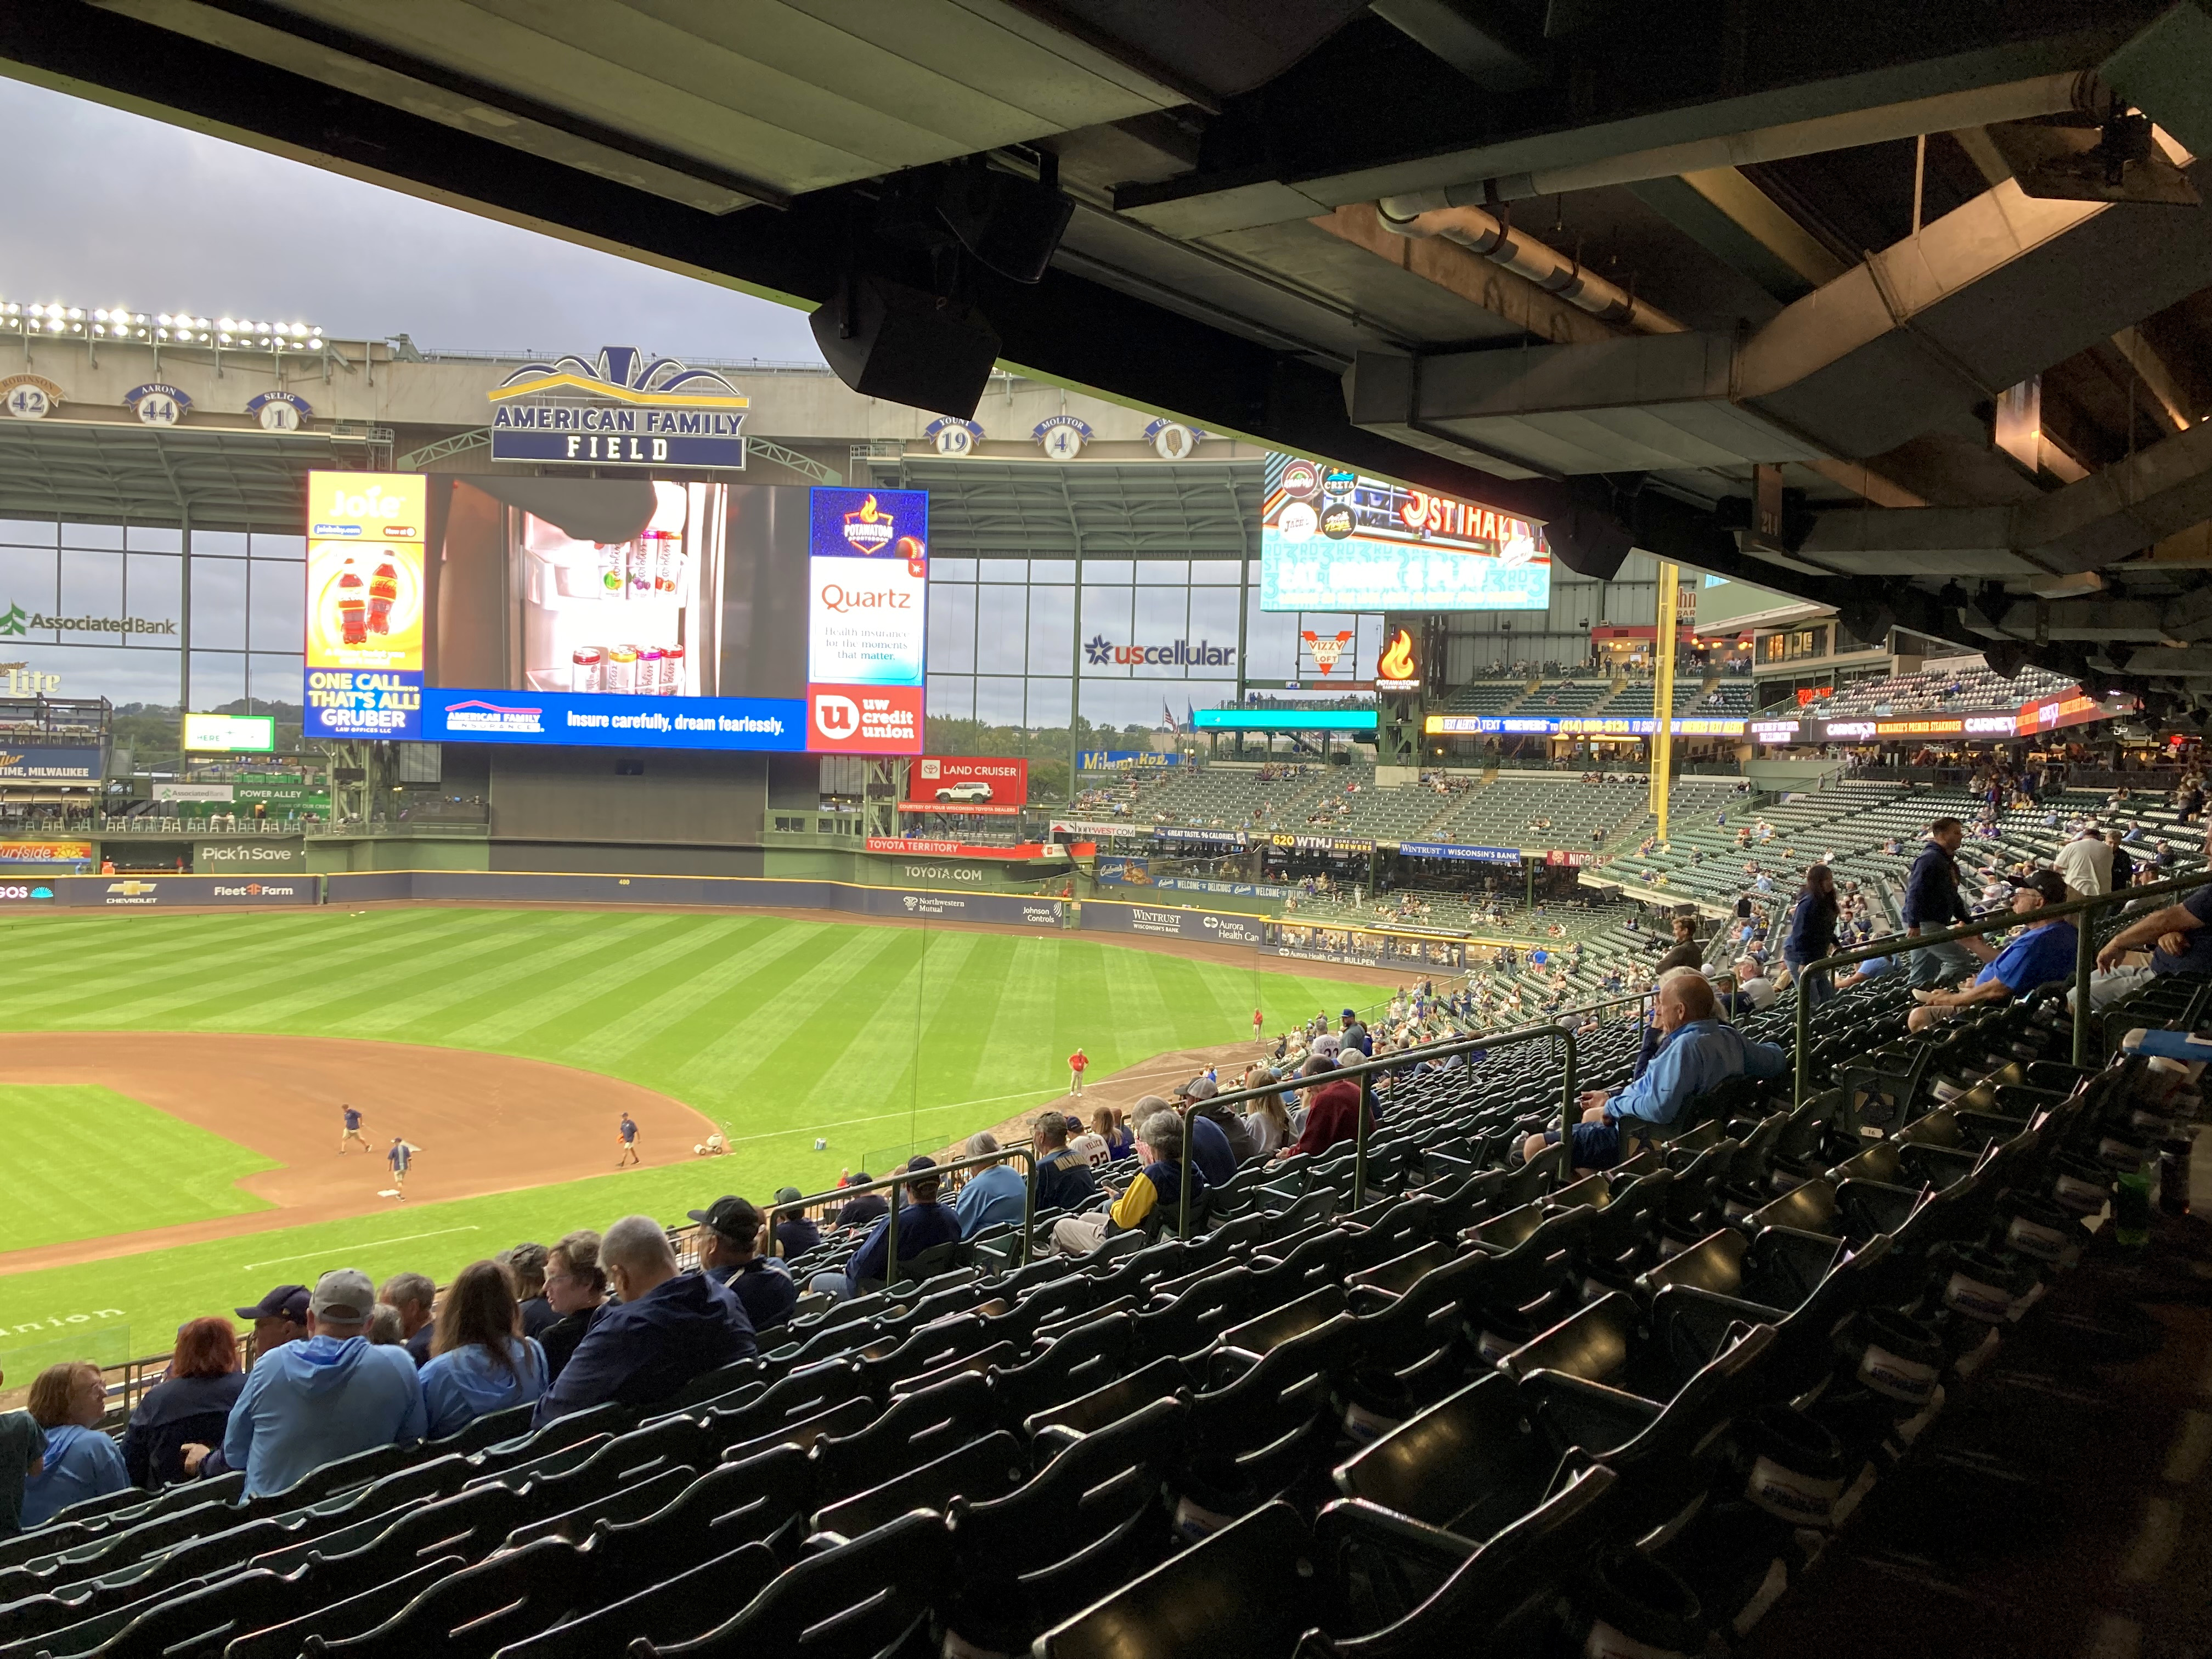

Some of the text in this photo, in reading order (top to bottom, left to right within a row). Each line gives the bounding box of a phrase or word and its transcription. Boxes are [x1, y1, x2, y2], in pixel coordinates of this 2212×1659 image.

[2, 375, 54, 390] ROBINSON
[142, 385, 177, 396] AARON
[264, 392, 296, 402] SELIG
[12, 392, 44, 412] 42
[143, 400, 174, 420] 44
[274, 409, 285, 428] 1
[495, 407, 745, 435] AMERICAN FAMILY
[1042, 417, 1085, 431] MOLITOR
[567, 436, 667, 461] FIELD
[941, 432, 968, 453] 19
[1054, 431, 1067, 453] 4
[330, 486, 400, 518] Joie
[844, 524, 893, 538] POTAWATOMI
[822, 584, 911, 613] Quartz
[30, 613, 178, 635] Associated Bank
[825, 626, 909, 637] Health insurance
[843, 639, 857, 647] the
[862, 641, 907, 650] moments
[1310, 642, 1344, 650] VIZZY
[838, 651, 895, 661] that matter.
[1115, 639, 1236, 665] uscellular
[8, 668, 61, 698] Lite
[309, 672, 353, 689] ONE
[308, 691, 420, 710] THAT'S ALL!
[862, 699, 889, 710] uw
[321, 709, 405, 727] GRUBER
[447, 712, 540, 723] AMERICAN FAMILY
[567, 710, 784, 736] Insure carefully, dream fearlessly.
[862, 710, 913, 724] credit
[862, 724, 914, 738] union
[1444, 719, 1457, 730] TEXT
[1457, 719, 1476, 730] ALERTS
[1482, 719, 1500, 730] TEXT
[1550, 723, 1558, 731] TO
[1559, 720, 1582, 733] (414)
[1632, 721, 1640, 732] TO
[1878, 723, 1908, 733] MILWAUKEE'S
[1909, 721, 1929, 732] PREMIER
[1931, 720, 1962, 731] STEAKHOUSE
[29, 767, 89, 777] MILWAUKEE
[944, 765, 1017, 777] LAND CRUISER
[1209, 832, 1235, 840] CALORIES.
[1273, 834, 1332, 849] 620 WTMJ
[869, 840, 958, 853] TOYOTA TERRITORY
[1402, 843, 1517, 860] WINTRUST WISCONSIN'S BANK
[202, 848, 235, 860] Pick
[252, 848, 291, 860] Save
[905, 866, 982, 881] TOYOTA.COM
[215, 887, 293, 896] Fleet Farm
[1177, 880, 1200, 890] WELCOME
[1208, 883, 1231, 893] DELICIOUS
[1256, 887, 1279, 898] WELCOME
[919, 898, 964, 907] Northwestern
[1023, 907, 1049, 915] Johnson
[1132, 909, 1181, 924] WINTRUST
[1028, 915, 1054, 923] Controls
[1220, 920, 1244, 930] Aurora
[1133, 923, 1165, 932] WISCONSIN'S
[1218, 929, 1243, 940] Health
[1344, 956, 1375, 967] BULLPEN
[1085, 1139, 1103, 1151] YELICH
